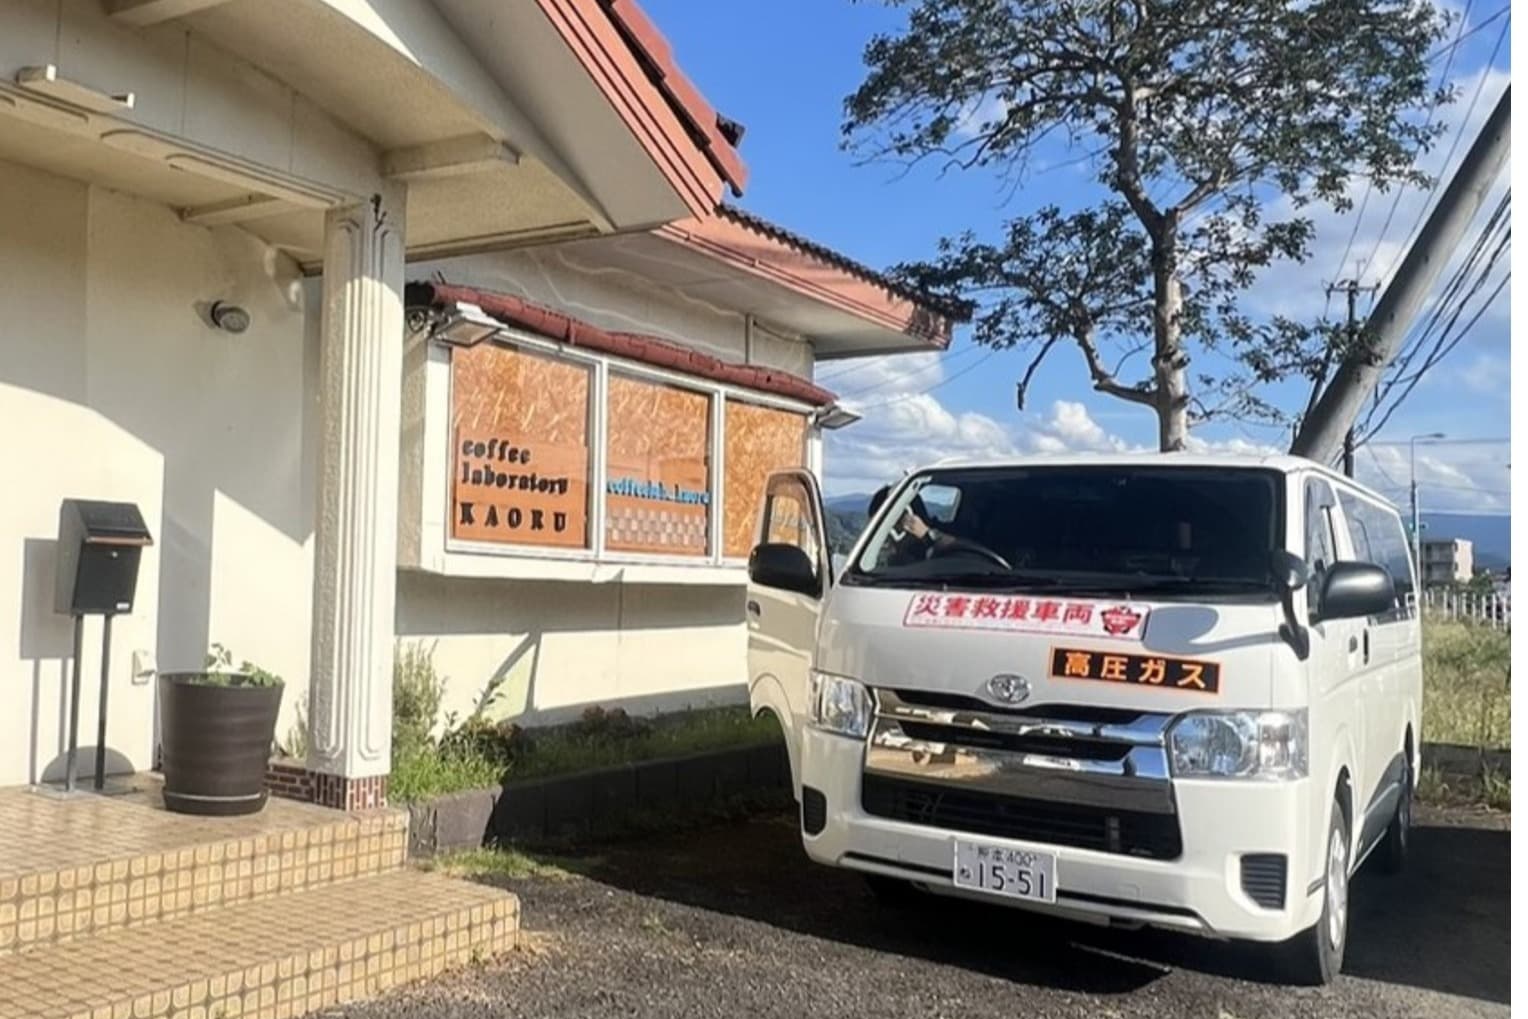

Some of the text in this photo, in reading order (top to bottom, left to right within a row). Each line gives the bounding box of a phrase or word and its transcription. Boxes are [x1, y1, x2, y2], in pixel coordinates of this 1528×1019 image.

[462, 438, 531, 465] coffee
[461, 462, 568, 495] laboratory
[460, 502, 567, 532] KAORU
[914, 596, 1095, 625] 災害救援車両
[1064, 651, 1206, 689] 高圧ガス
[979, 863, 1045, 898] 15-51
